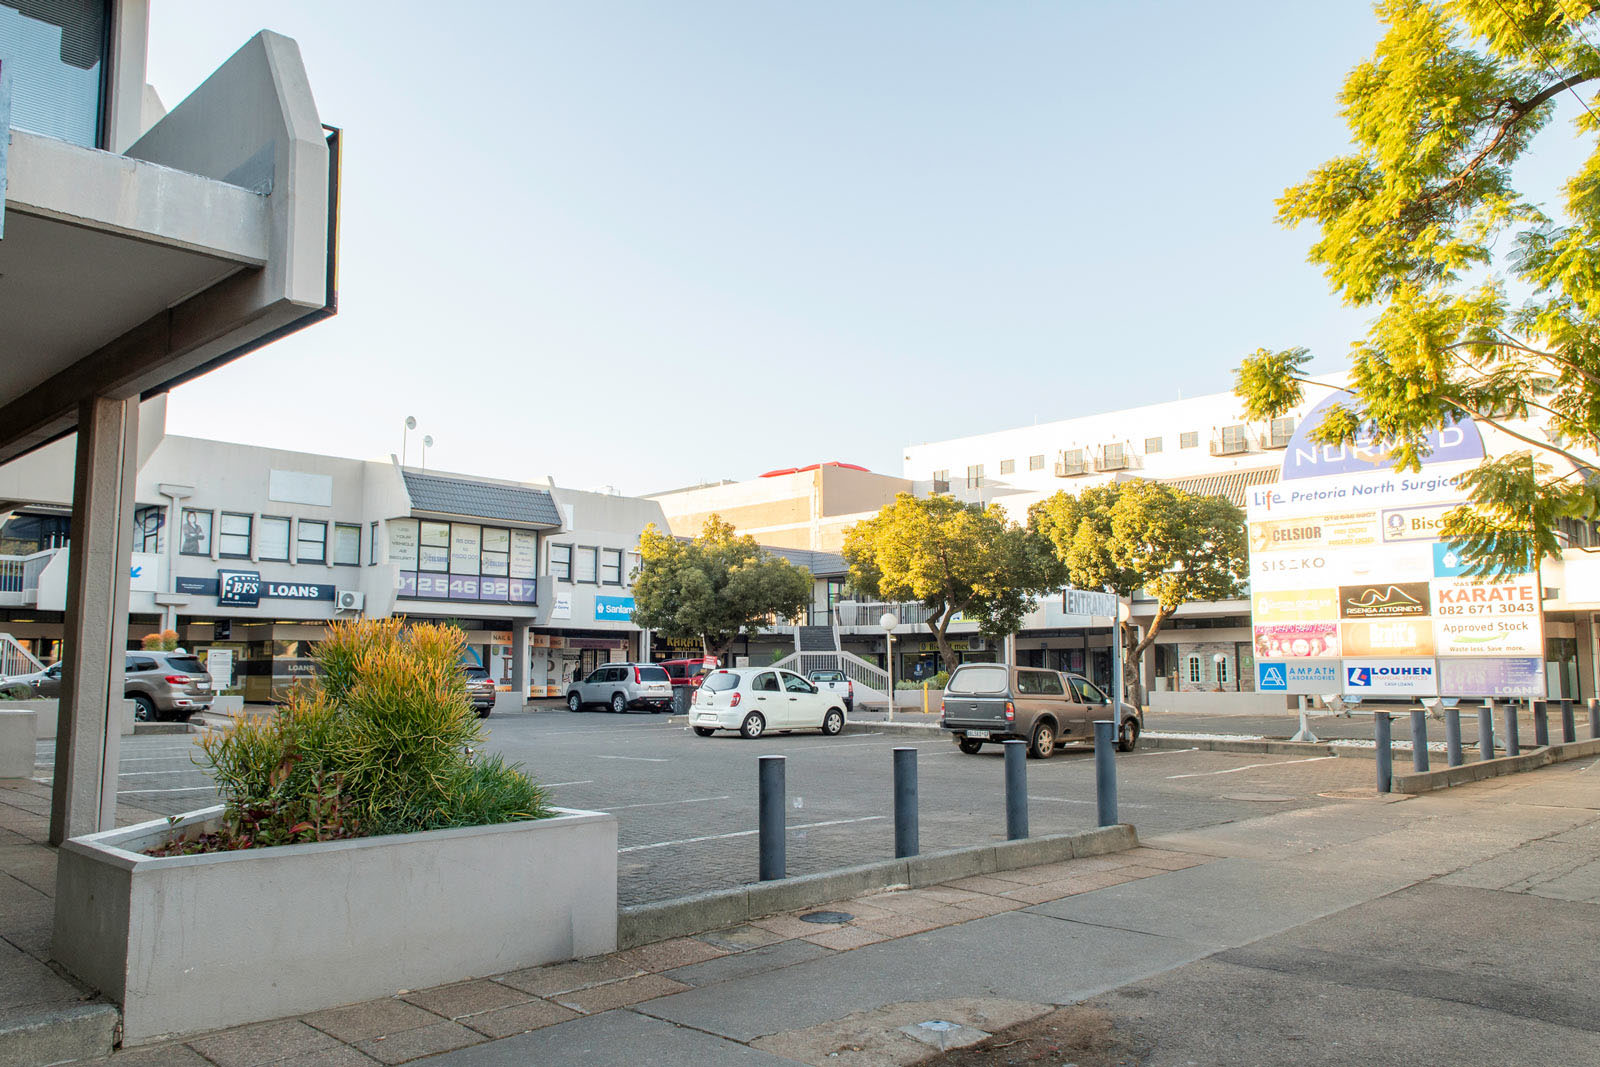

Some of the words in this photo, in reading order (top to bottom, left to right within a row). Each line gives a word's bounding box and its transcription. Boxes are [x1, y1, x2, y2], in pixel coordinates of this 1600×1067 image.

[1295, 427, 1464, 466] NORMD
[1254, 490, 1286, 510] Life
[1291, 487, 1346, 503] Pretoria
[1352, 480, 1395, 497] North
[1272, 526, 1322, 542] CELSIOR
[232, 582, 259, 595] BFS
[268, 584, 319, 598] LOANS
[434, 579, 477, 594] 546
[482, 582, 535, 597] 9207
[1438, 586, 1534, 604] KARATE
[605, 604, 634, 614] Sanlam
[1068, 591, 1116, 617] ENTRANCE
[1346, 607, 1378, 615] RISENGA
[1379, 605, 1423, 613] ATTORNEYS
[1439, 605, 1464, 616] 082
[1468, 604, 1492, 614] 671
[1499, 602, 1535, 613] 3043
[1443, 622, 1494, 633] Approved
[1497, 620, 1529, 631] Stock
[287, 664, 315, 672] LOANS
[1289, 667, 1335, 675] AMPATH
[1371, 667, 1432, 675] LOUHEN
[1494, 685, 1541, 695] LOANS
